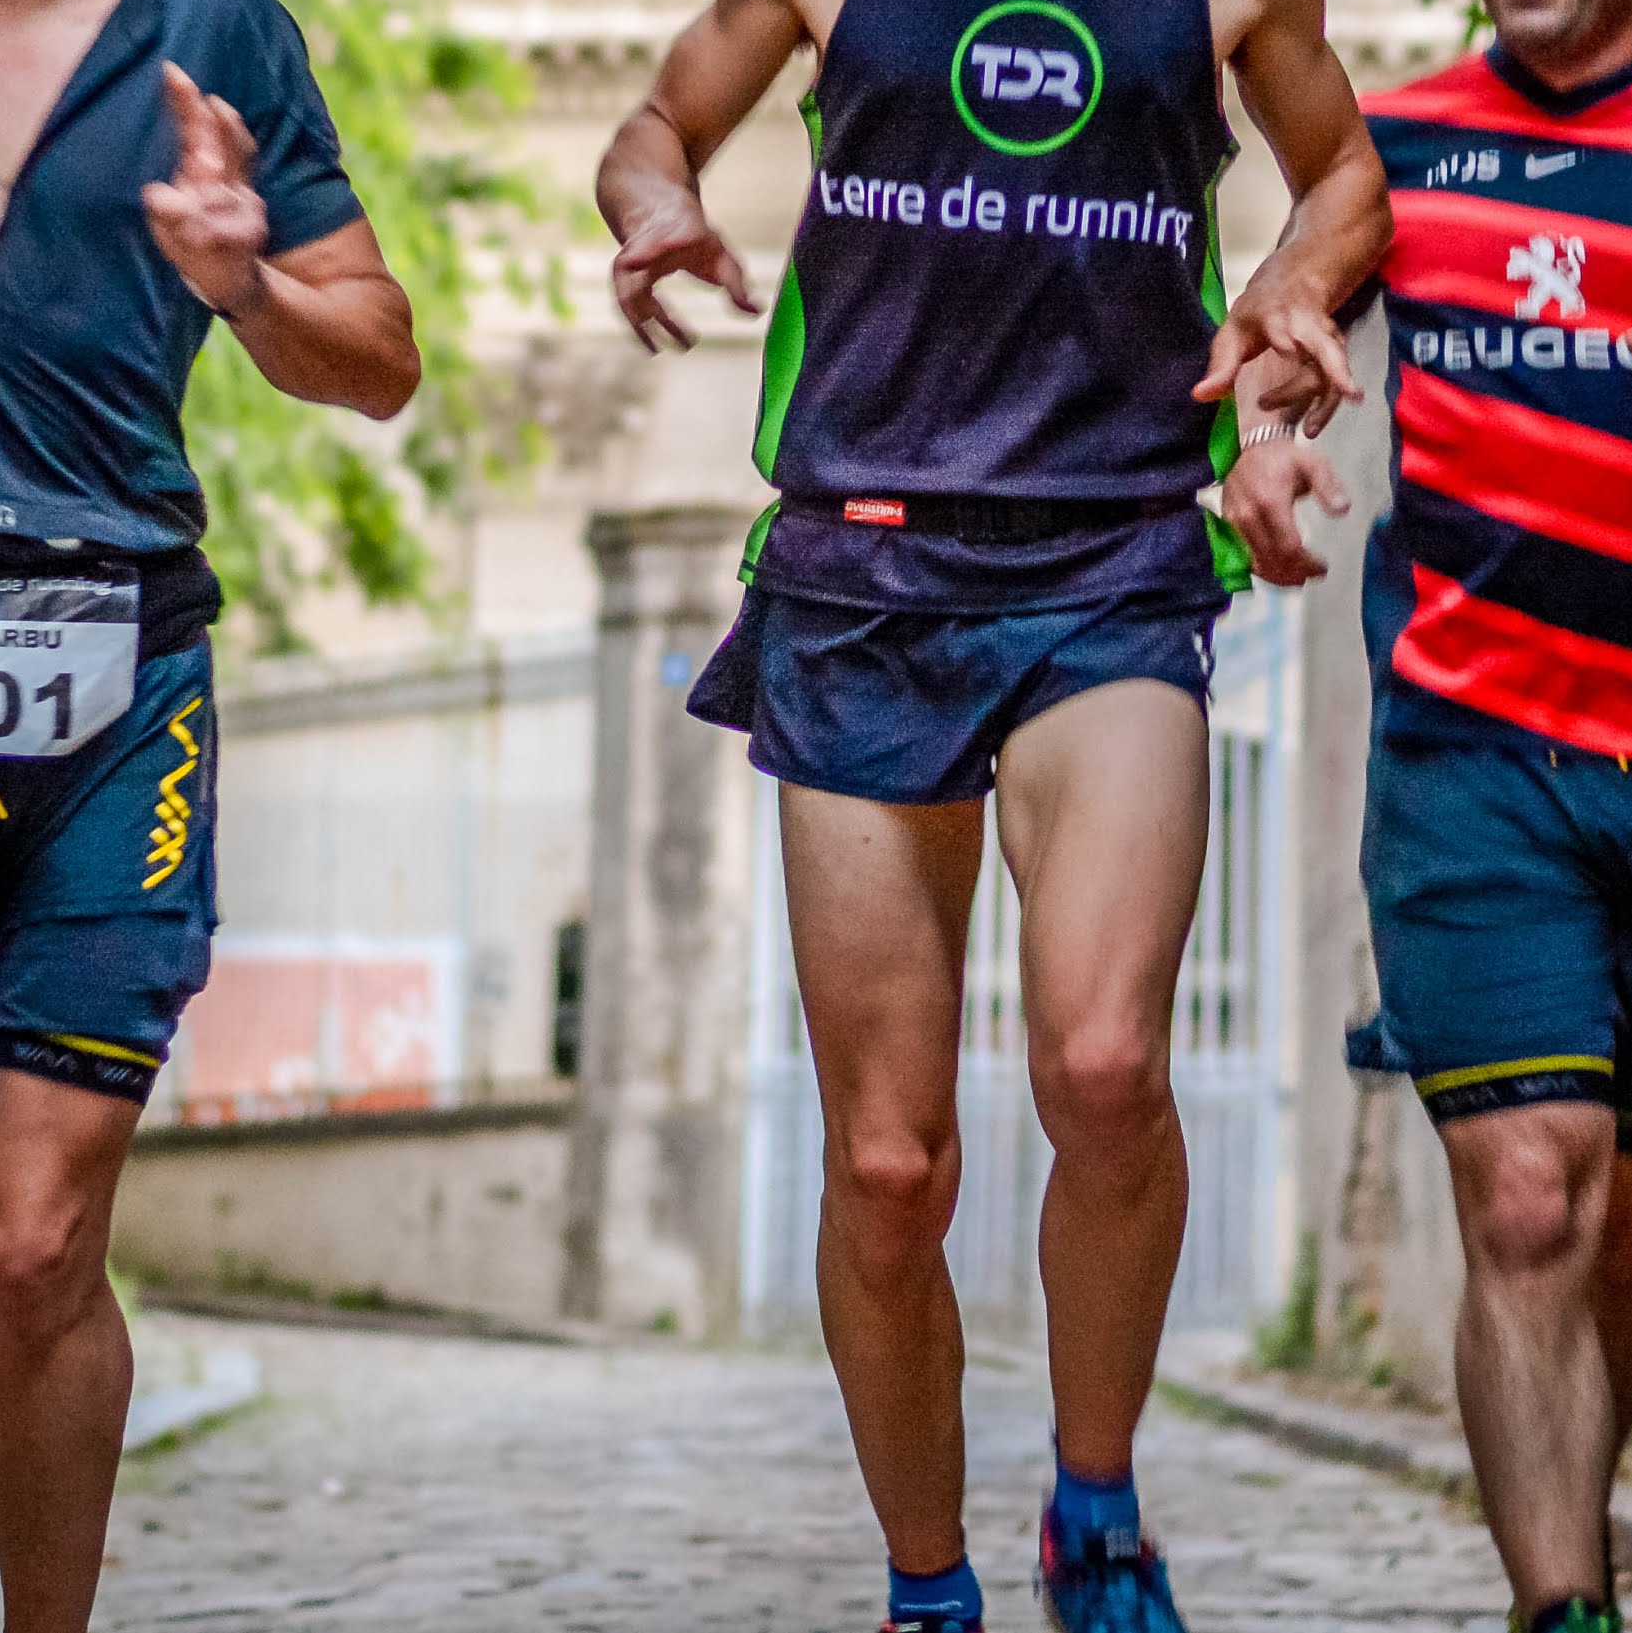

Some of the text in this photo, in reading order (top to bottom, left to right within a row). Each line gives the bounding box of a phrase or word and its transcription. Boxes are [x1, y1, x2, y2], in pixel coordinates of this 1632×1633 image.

[971, 43, 1084, 108] TDR
[819, 169, 926, 226] terre
[940, 175, 1007, 232] de
